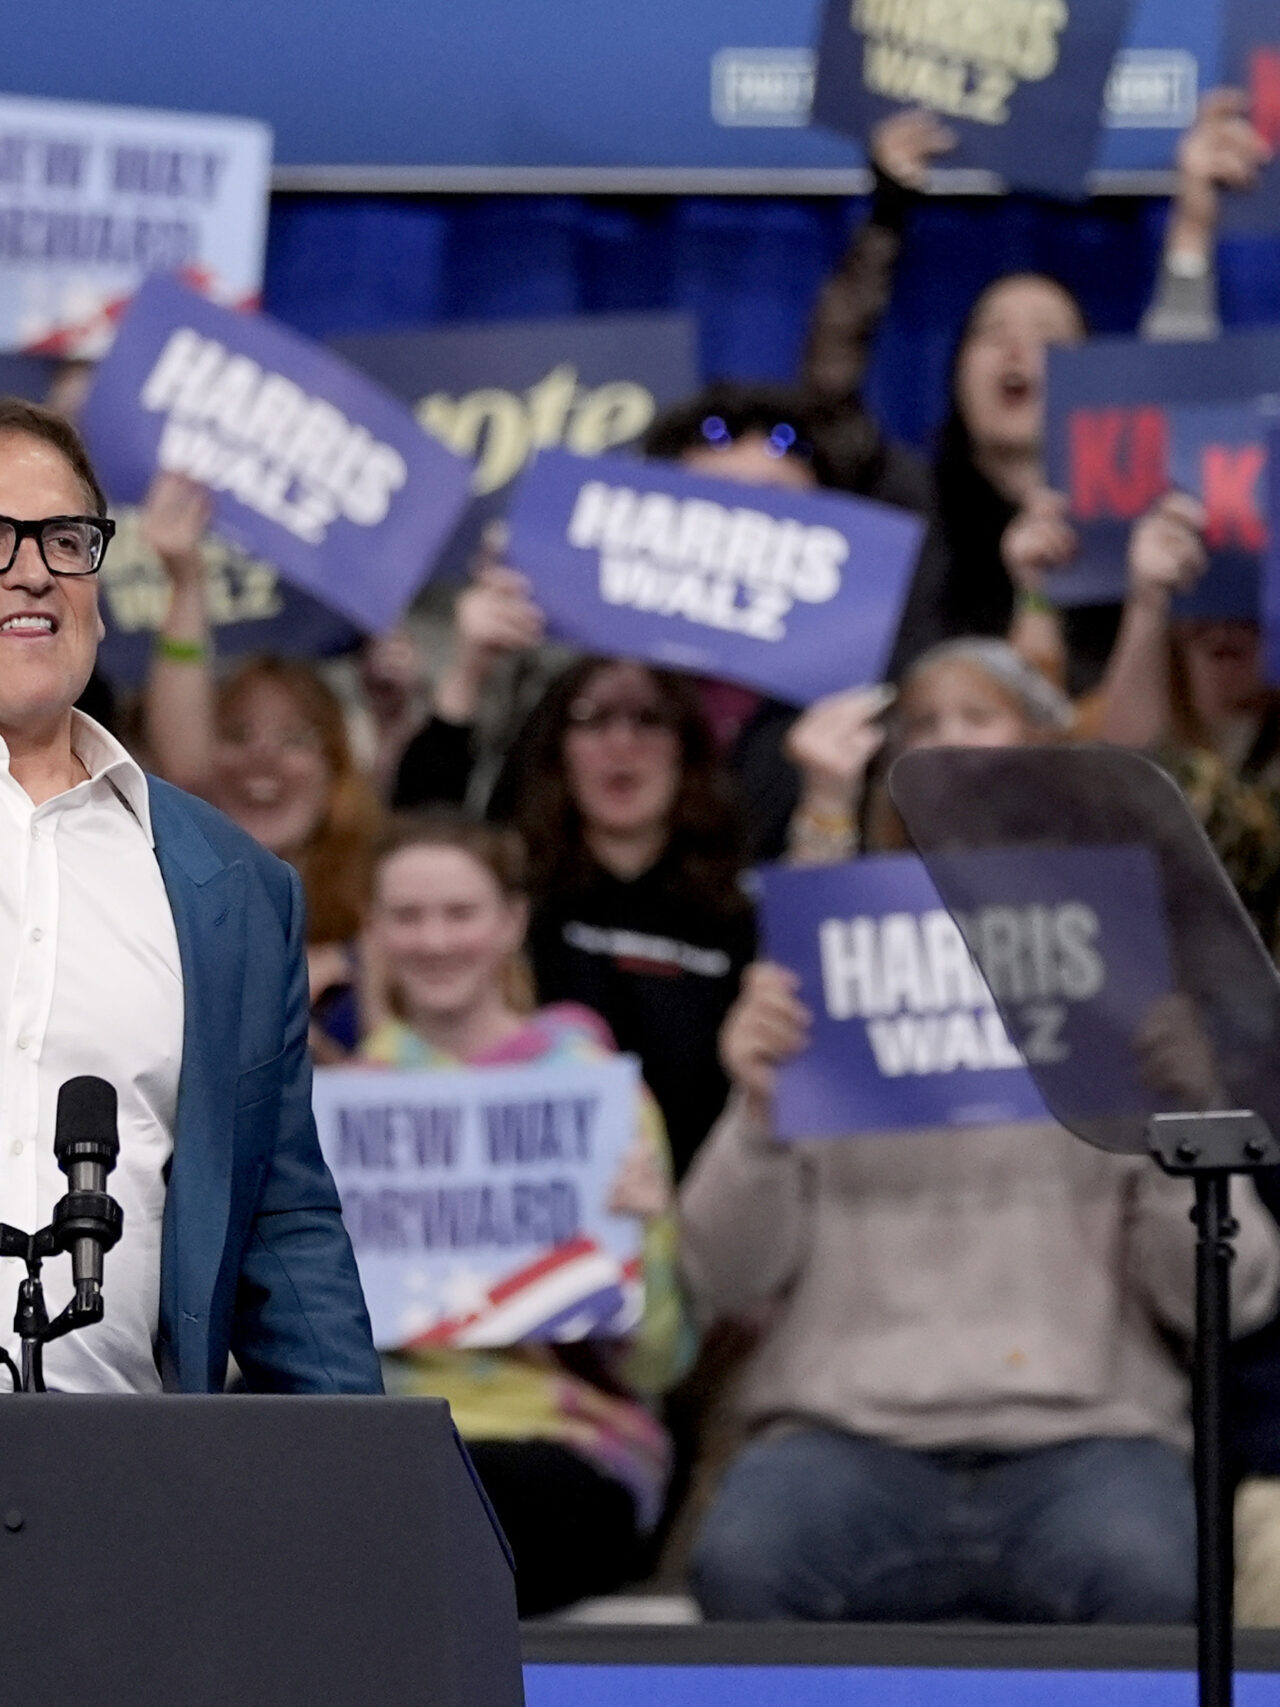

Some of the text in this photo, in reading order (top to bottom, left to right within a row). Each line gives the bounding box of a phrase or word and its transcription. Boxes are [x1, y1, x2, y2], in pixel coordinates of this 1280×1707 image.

[863, 41, 1017, 125] WALZ
[111, 143, 232, 202] WAY
[140, 326, 407, 527] HARRIS
[158, 420, 342, 545] WALZ
[567, 479, 850, 604] HARRIS
[599, 556, 794, 643] WALZ
[820, 901, 1106, 1021] HARRIS
[866, 1004, 1070, 1078] WALZ
[334, 1094, 601, 1170] NEW WAY
[338, 1177, 581, 1258] ORWARD
